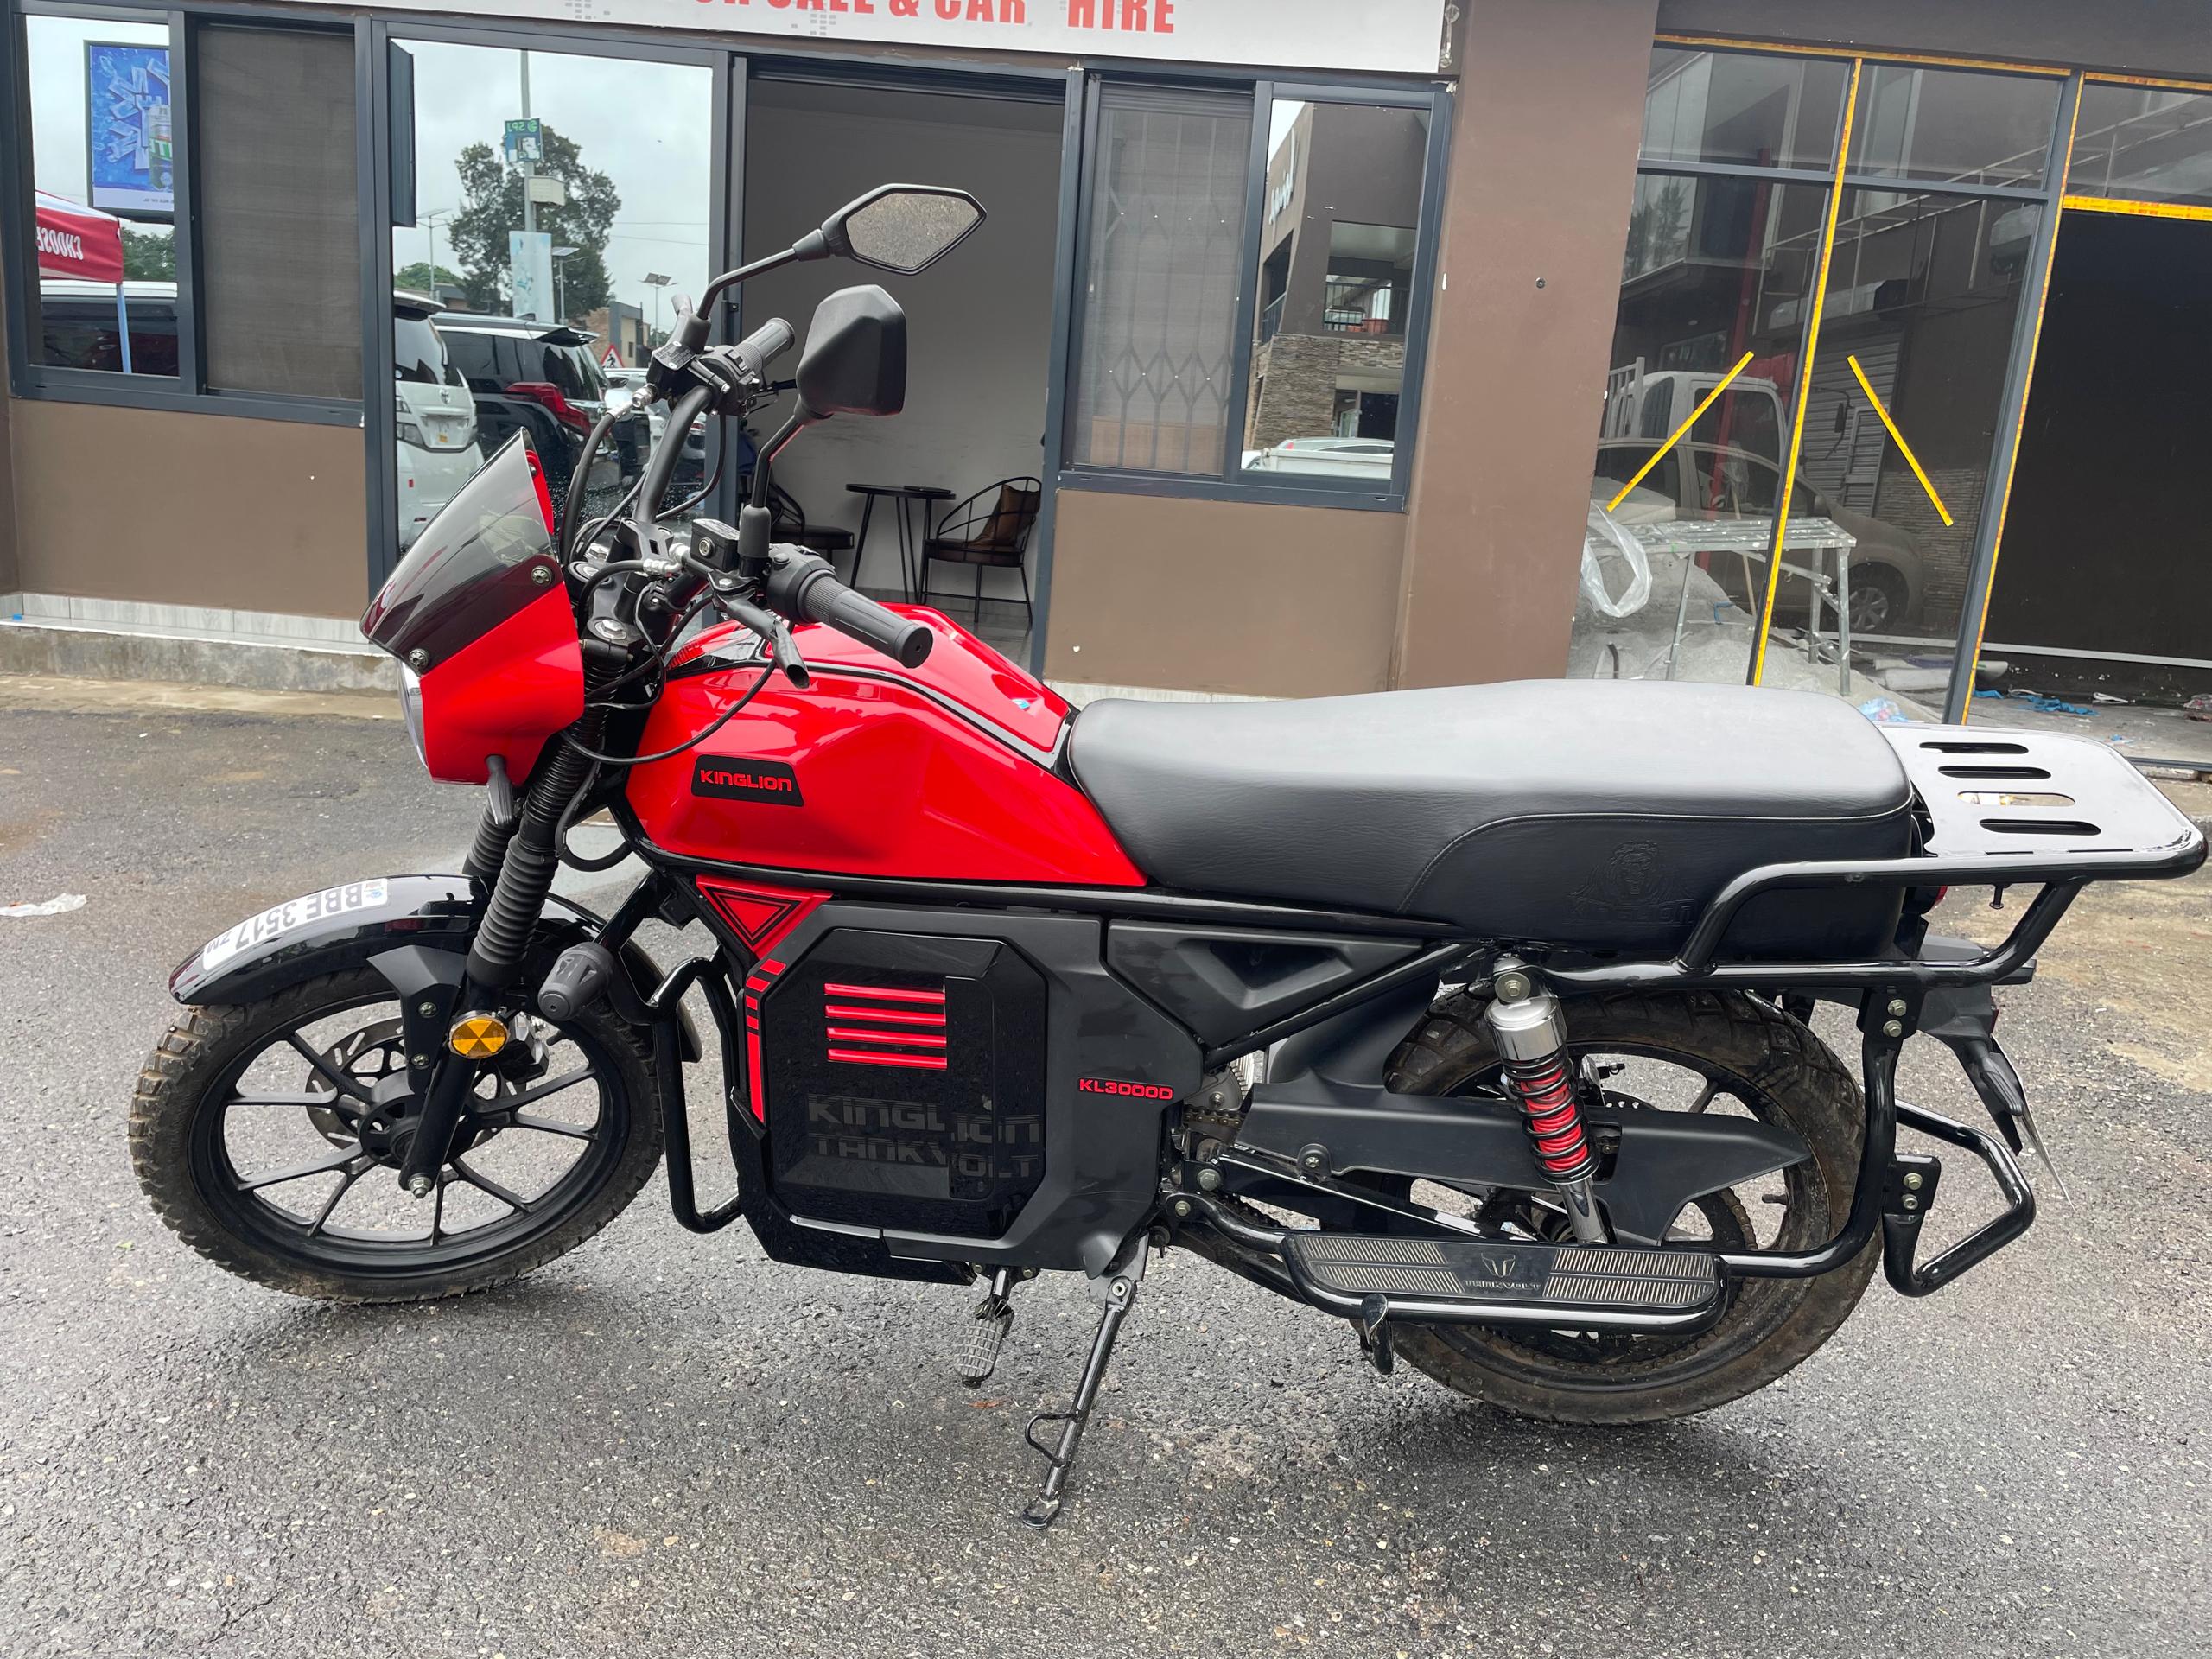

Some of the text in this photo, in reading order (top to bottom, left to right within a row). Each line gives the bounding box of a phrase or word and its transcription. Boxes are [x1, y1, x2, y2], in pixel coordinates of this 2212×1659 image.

[1068, 0, 1173, 33] HIRE
[700, 769, 792, 791] KINGLION
[306, 883, 363, 920] BBE
[235, 901, 297, 950] 3517
[1079, 1078, 1173, 1100] KL3000D
